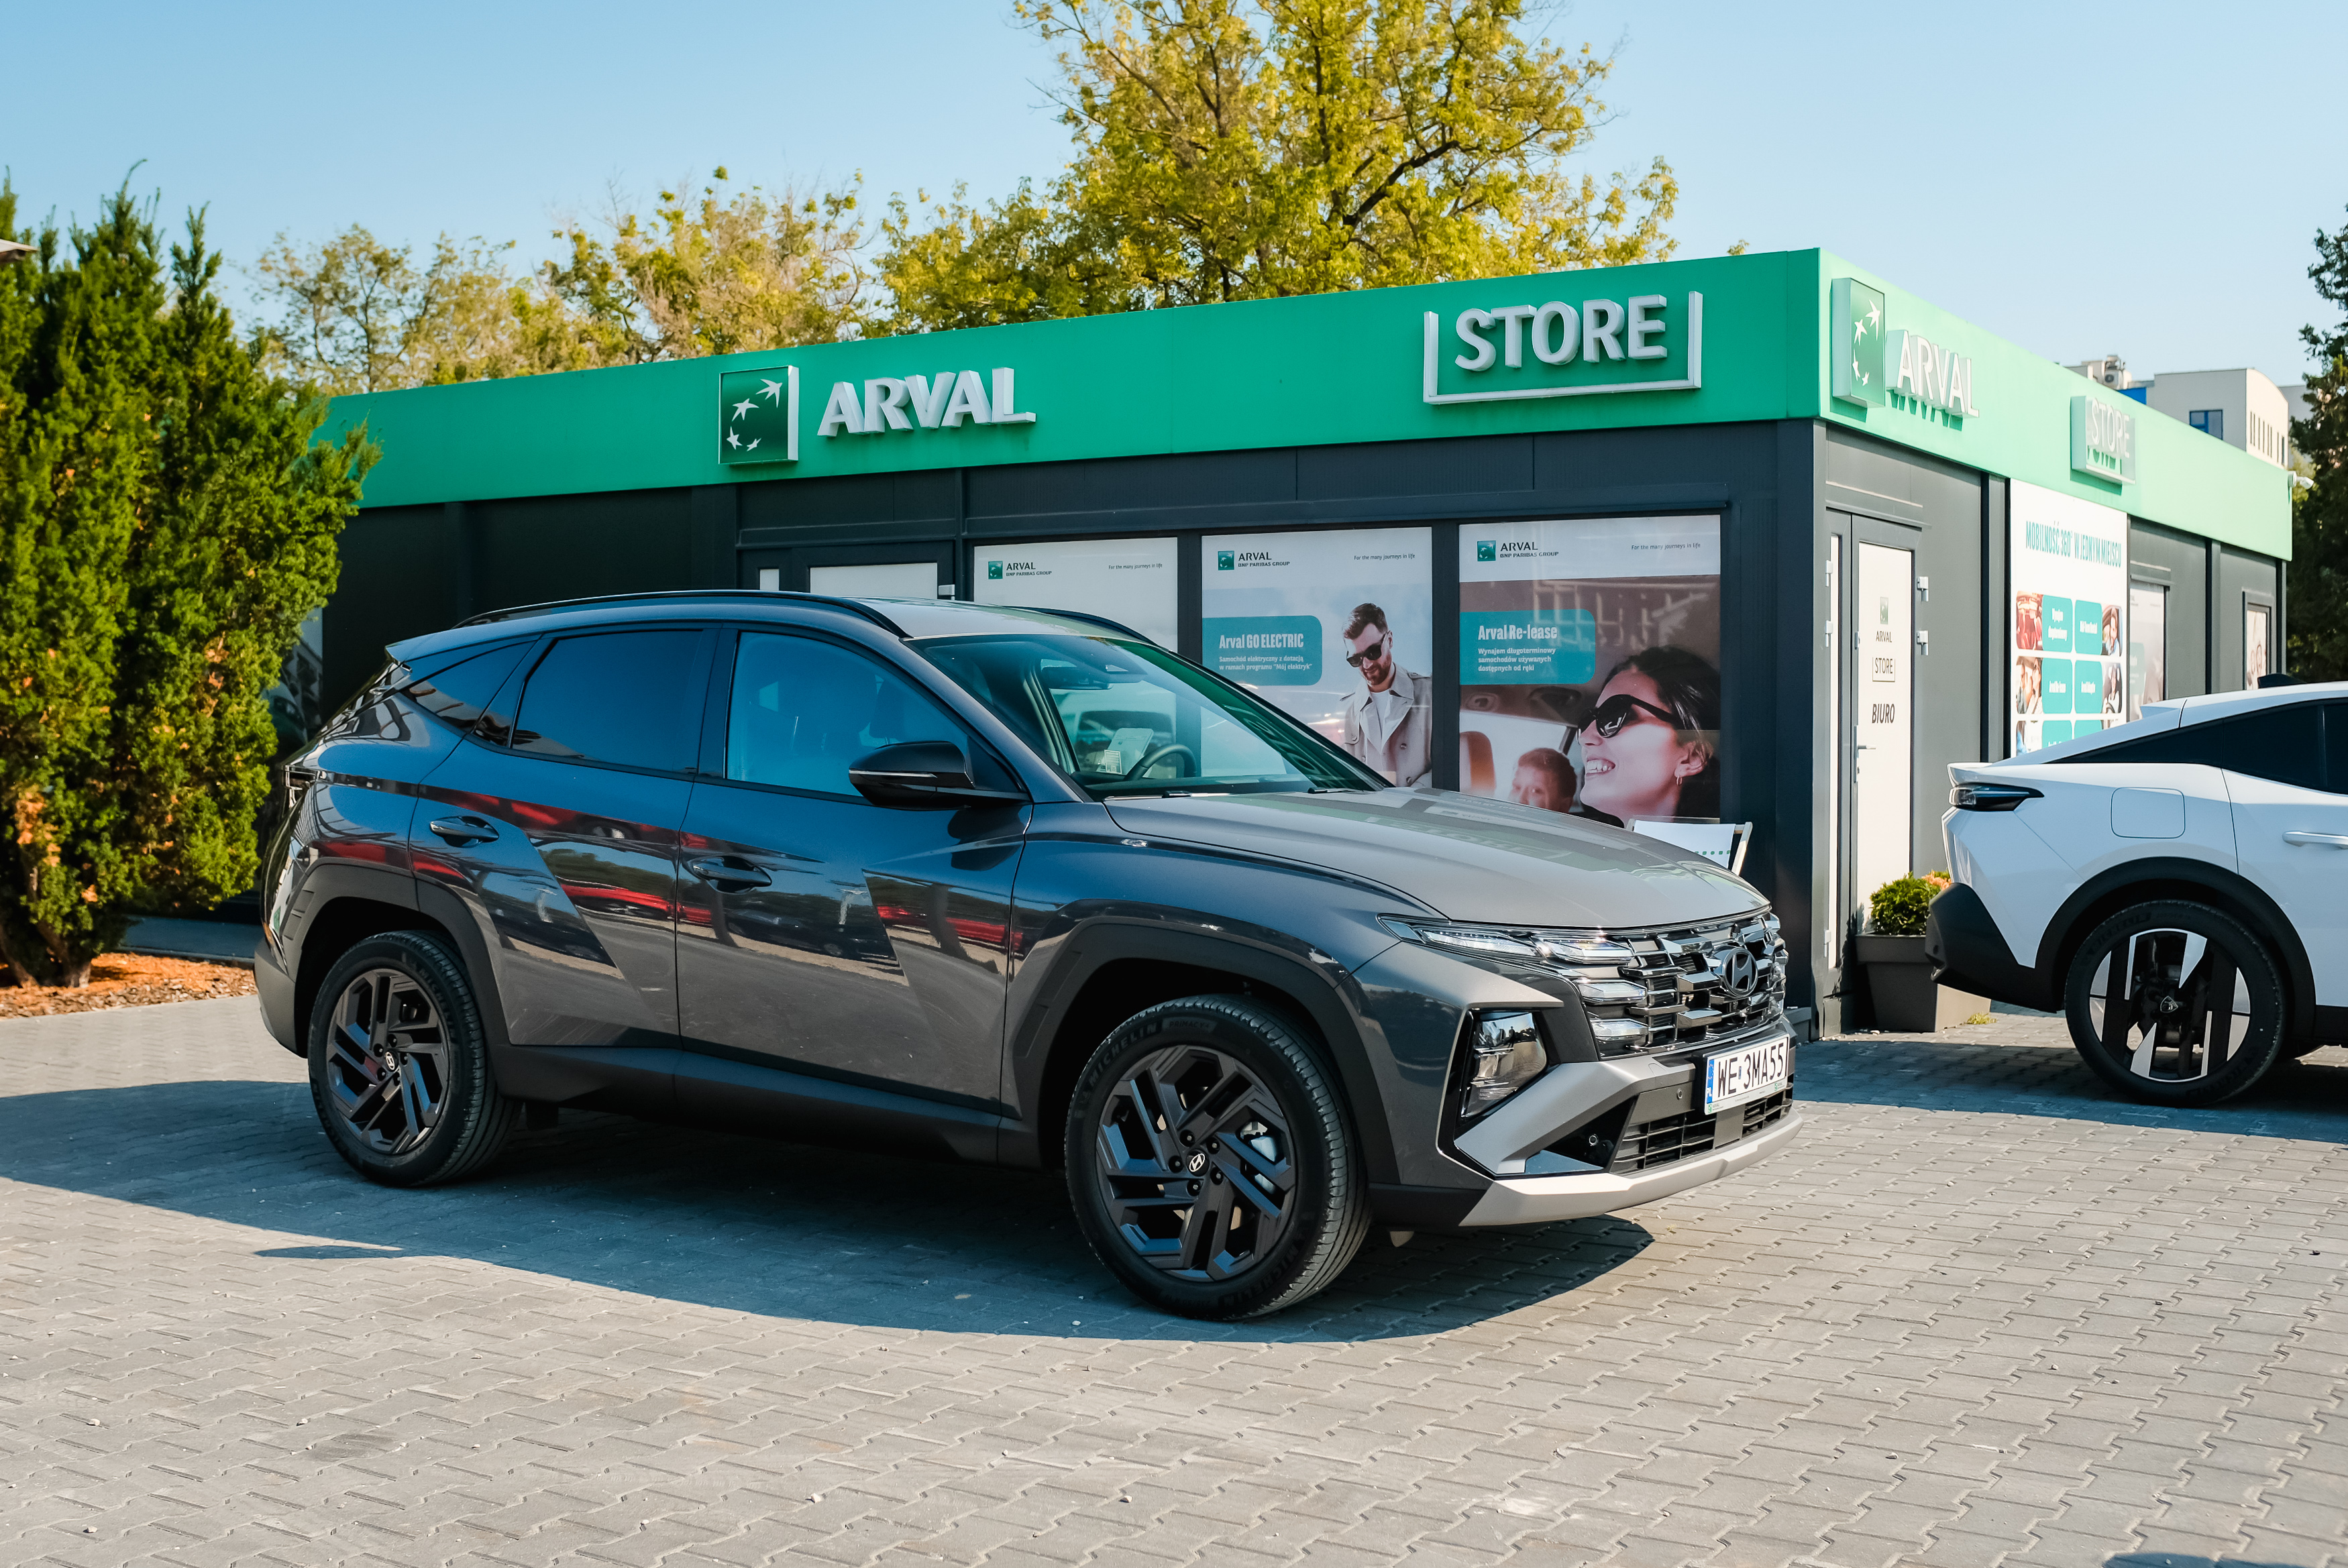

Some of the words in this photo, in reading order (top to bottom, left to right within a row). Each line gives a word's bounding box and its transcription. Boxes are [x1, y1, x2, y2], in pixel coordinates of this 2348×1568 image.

[1454, 294, 1668, 372] STORE
[1886, 329, 1980, 418] ARVAL
[817, 367, 1036, 437] ARVAL
[2089, 397, 2131, 459] STORE
[1500, 541, 1538, 551] ARVAL
[2025, 520, 2060, 555] MOBILNOŚĆ
[2074, 532, 2080, 559] W
[2080, 534, 2100, 564] JEDNYM
[2100, 539, 2122, 568] MIEJSCU
[1238, 551, 1272, 561] ARVAL
[1006, 562, 1036, 571] ARVAL
[1478, 624, 1507, 640] Arval
[1509, 624, 1558, 640] Re-lease
[1875, 630, 1892, 643] ARVAL
[1219, 634, 1245, 649] Arval
[1246, 634, 1260, 649] GO
[1261, 633, 1304, 648] ELECTRIC
[1478, 648, 1505, 656] Wynajem
[1507, 647, 1556, 656] długoterminowy
[1518, 655, 1552, 664] używanych
[1478, 665, 1512, 673] dostępnych
[1522, 664, 1535, 673] ręki
[1874, 657, 1893, 674] STORE
[1872, 704, 1895, 724] BIURO
[1169, 1020, 1205, 1028] PRIMACY
[1088, 1021, 1158, 1087] MICHELIN
[1717, 1056, 1738, 1098] WE
[1743, 1042, 1784, 1090] 3MA55
